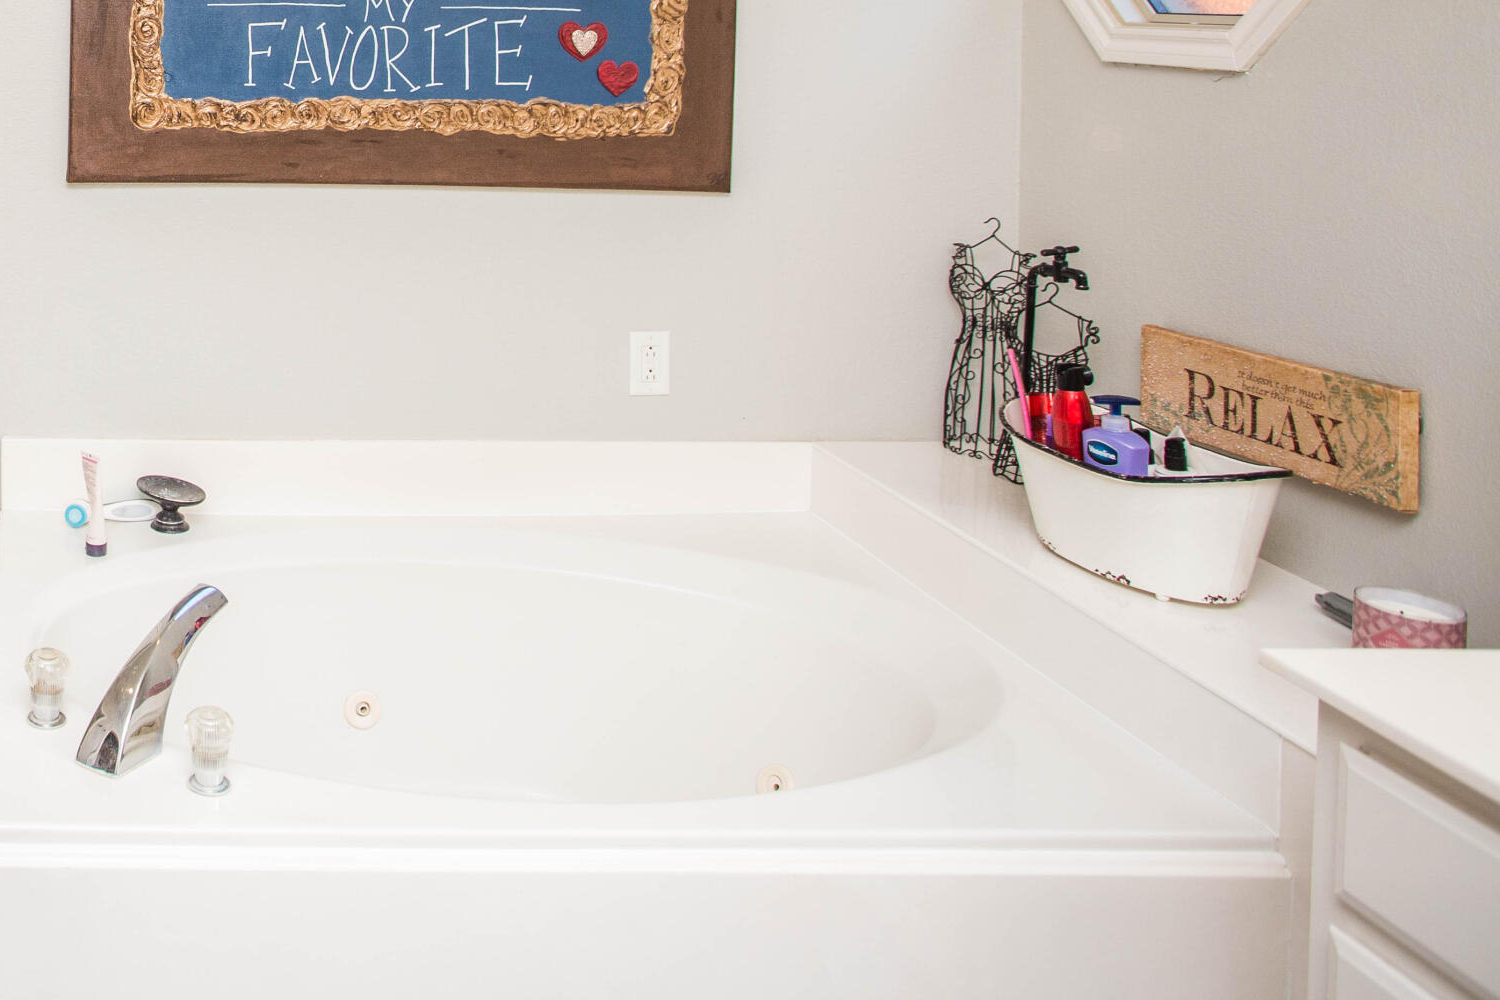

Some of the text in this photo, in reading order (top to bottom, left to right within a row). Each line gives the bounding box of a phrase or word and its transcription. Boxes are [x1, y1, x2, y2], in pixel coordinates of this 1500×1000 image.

[243, 14, 533, 93] FAVORITE
[1183, 367, 1343, 468] RELAX
[1299, 387, 1327, 403] much
